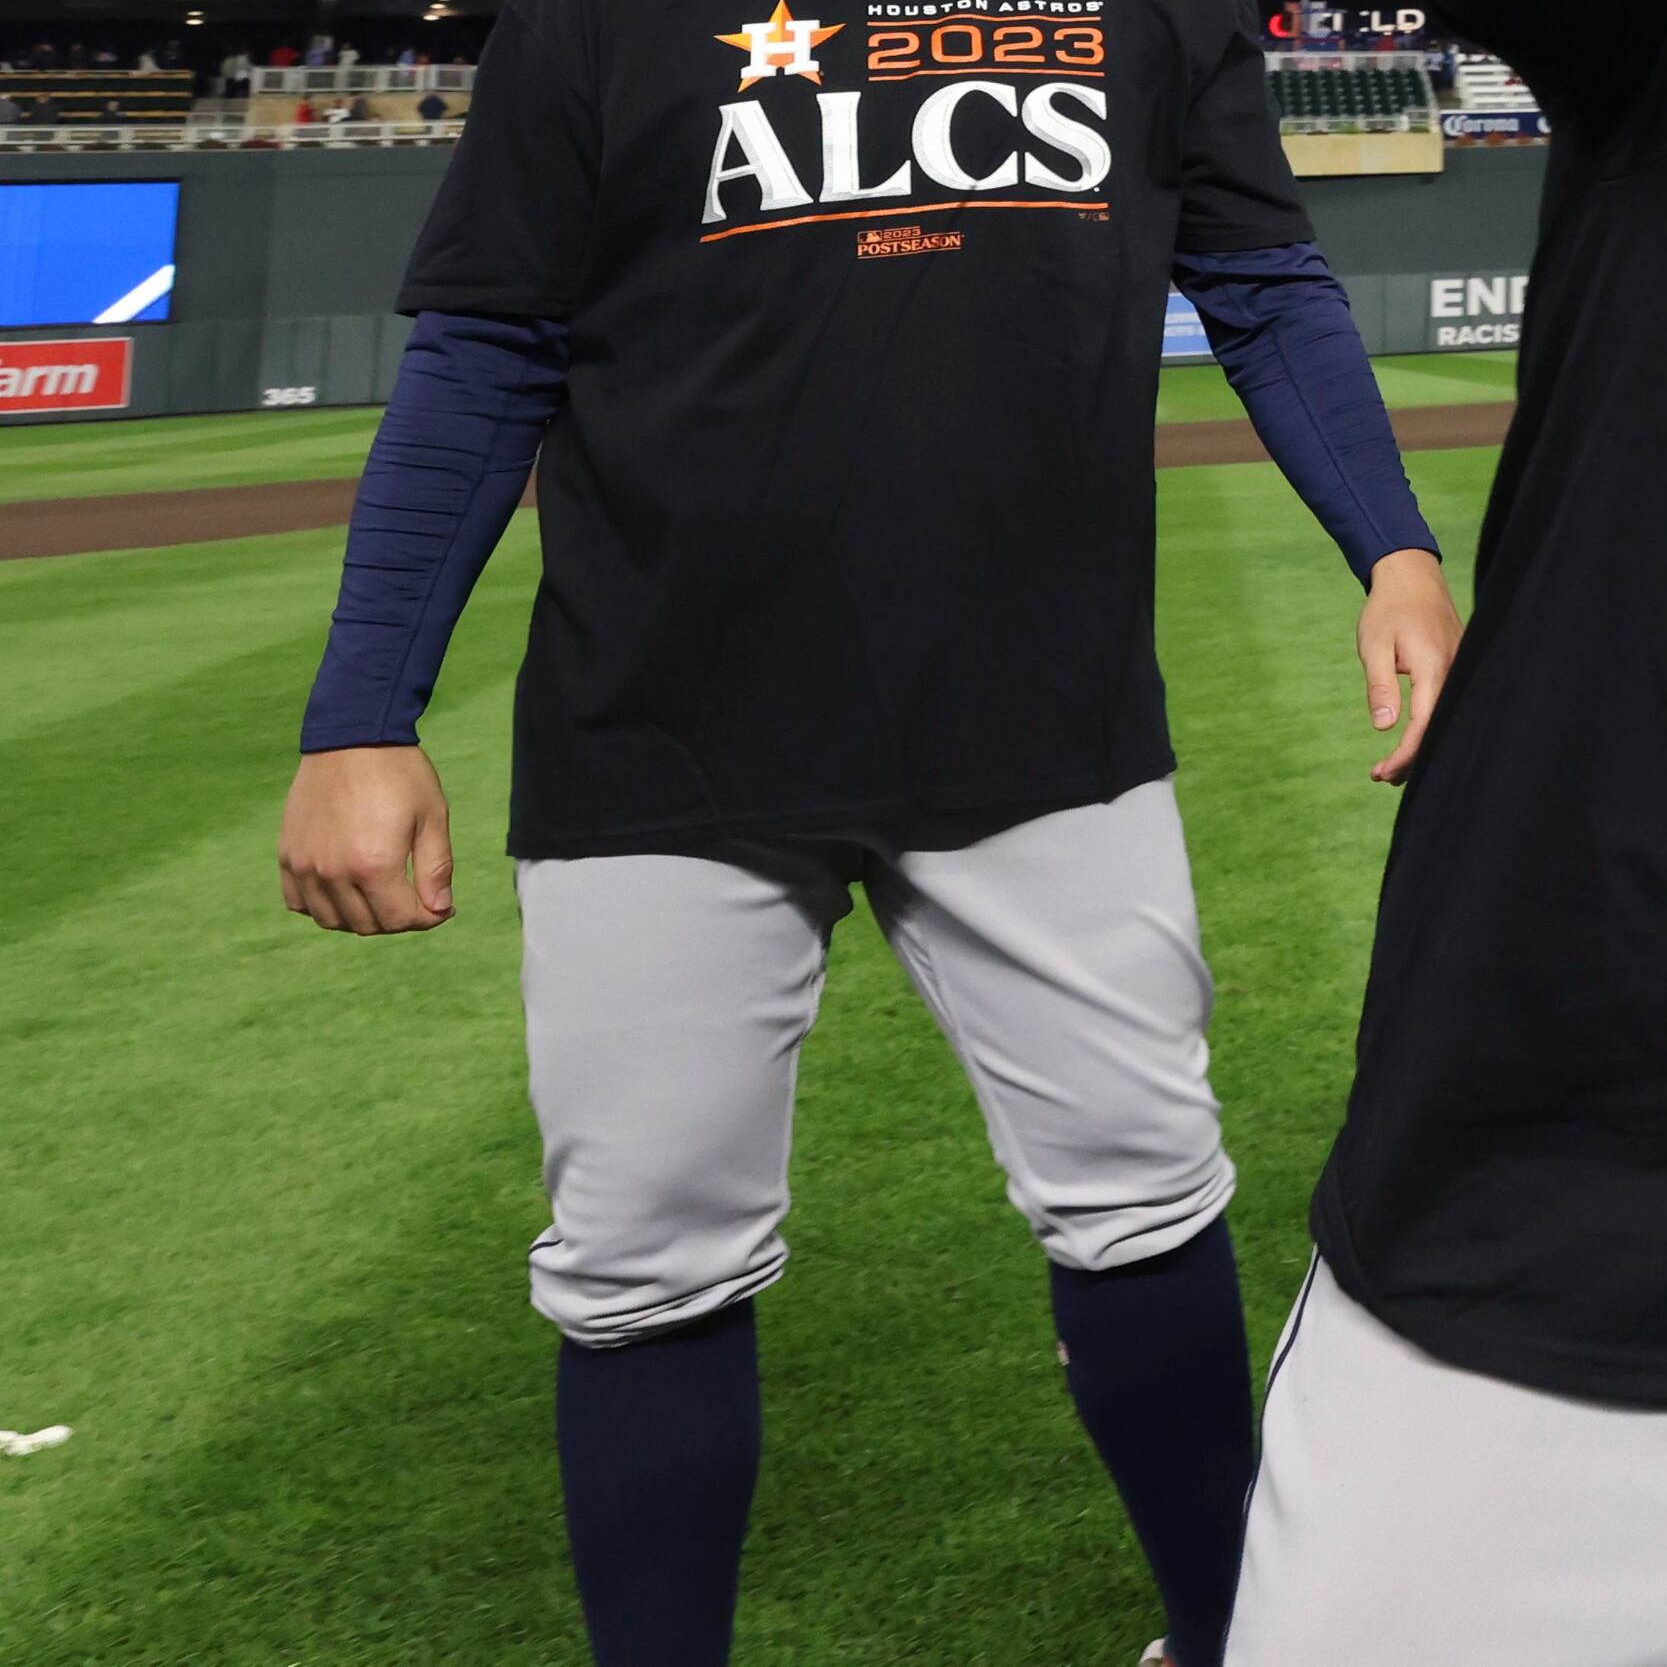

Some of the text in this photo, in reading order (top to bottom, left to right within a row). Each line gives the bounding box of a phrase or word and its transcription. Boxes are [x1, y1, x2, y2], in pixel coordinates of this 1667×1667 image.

[999, 0, 1103, 13] ASTROS
[867, 24, 1105, 69] 2023
[1444, 115, 1520, 136] Corona
[701, 80, 1112, 225] ALCS
[883, 228, 921, 239] 2023
[857, 235, 961, 256] POSTSEASON
[1437, 323, 1520, 346] RACIS
[263, 386, 315, 407] 365
